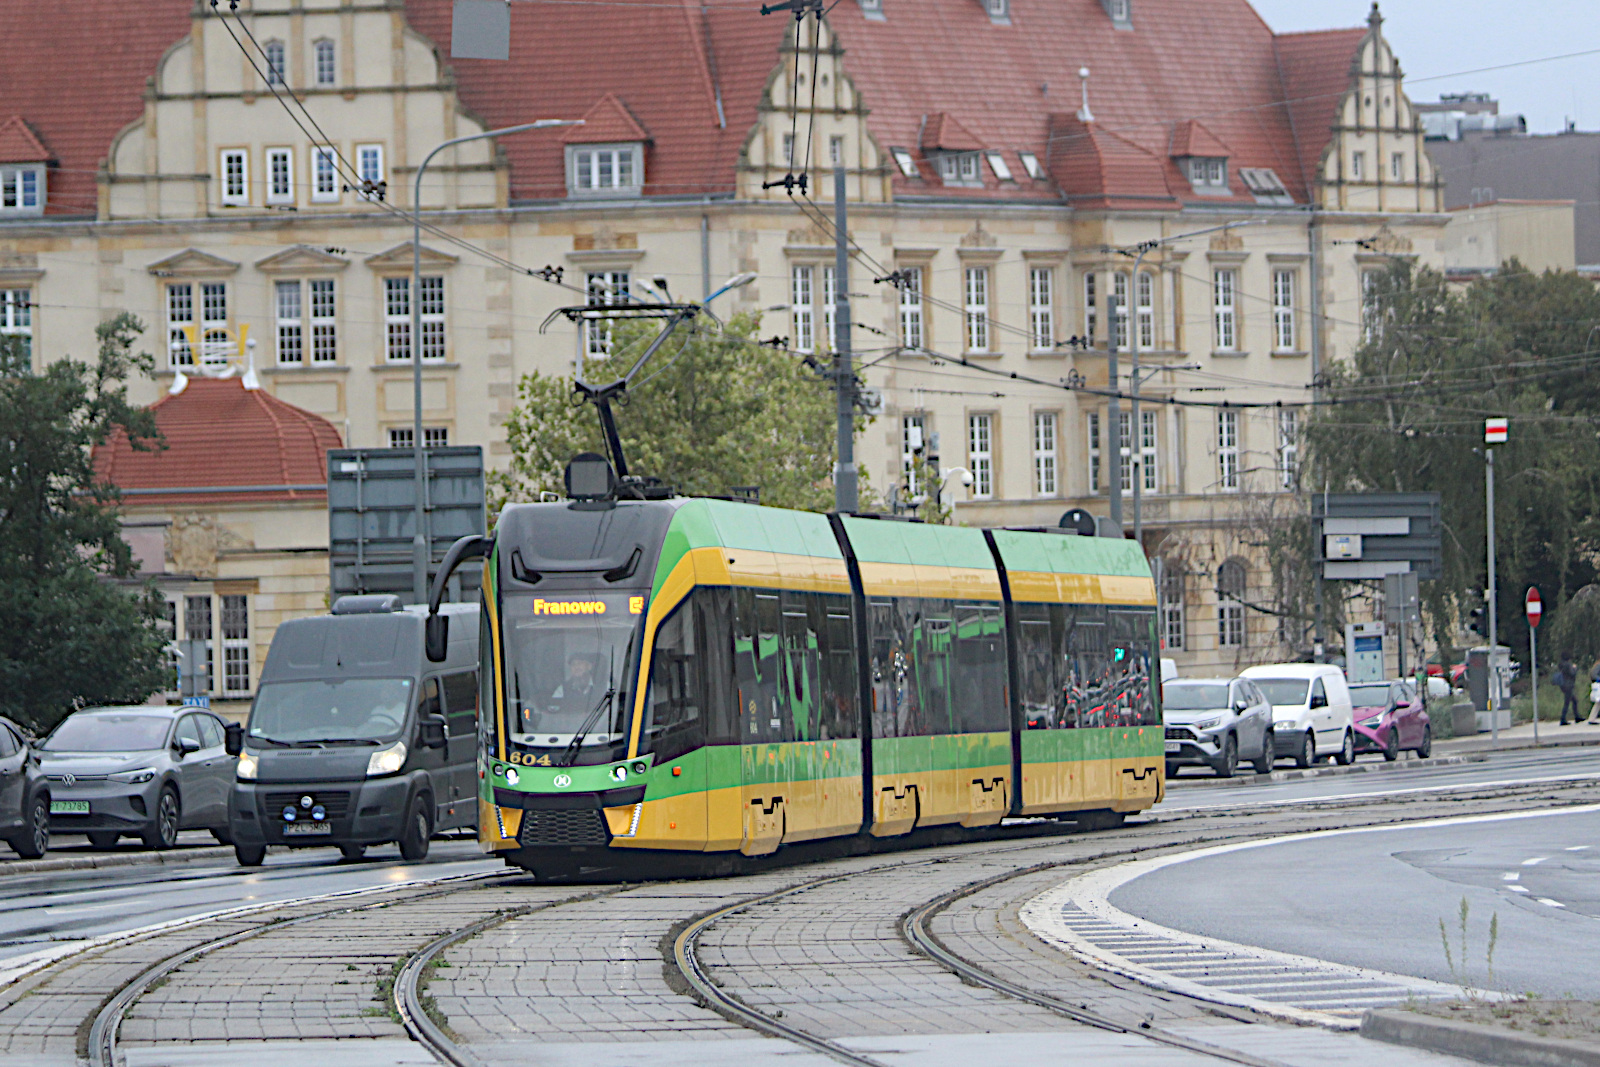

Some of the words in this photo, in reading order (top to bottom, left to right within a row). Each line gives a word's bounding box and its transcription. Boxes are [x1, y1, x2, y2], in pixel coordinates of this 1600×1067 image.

[533, 598, 606, 615] Franowo
[184, 697, 208, 708] TAXI
[509, 751, 552, 767] 604
